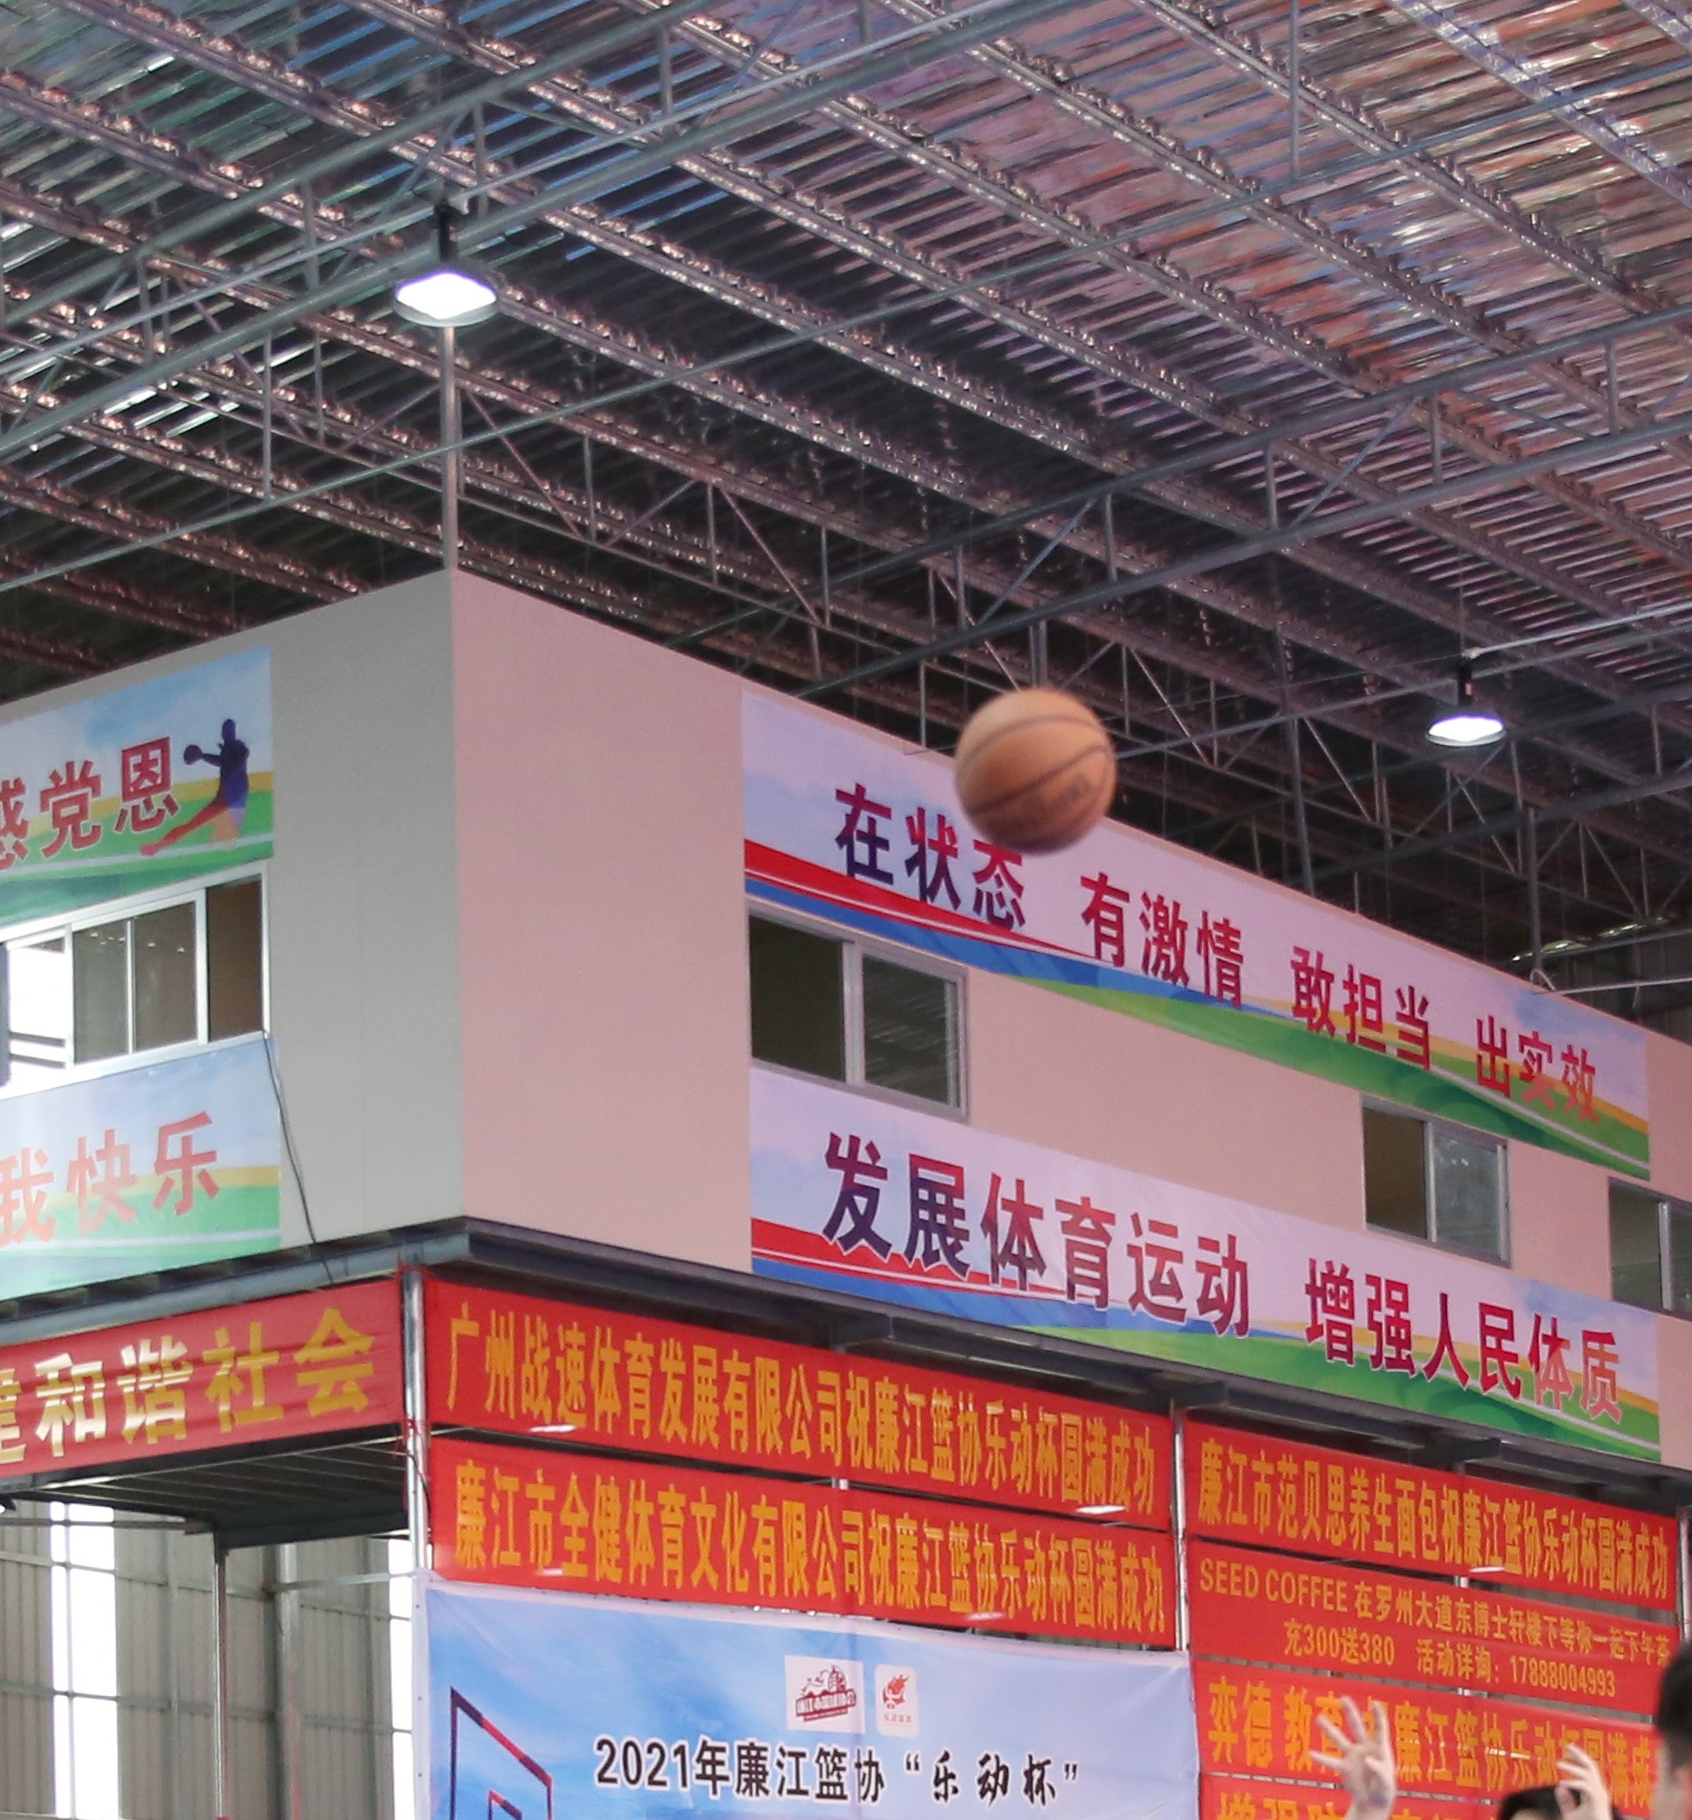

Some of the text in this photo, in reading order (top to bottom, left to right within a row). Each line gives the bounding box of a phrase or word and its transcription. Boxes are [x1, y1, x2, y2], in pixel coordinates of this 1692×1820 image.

[834, 784, 1600, 1124] 在状态 有激情 敢担当 出实效
[822, 1132, 1624, 1428] 发展体育运动 增强人民体质
[1199, 1558, 1262, 1597] SEED
[1265, 1568, 1349, 1613] COFFEE
[1283, 1619, 1396, 1666] 充300送380
[1510, 1655, 1616, 1698] 17888004993
